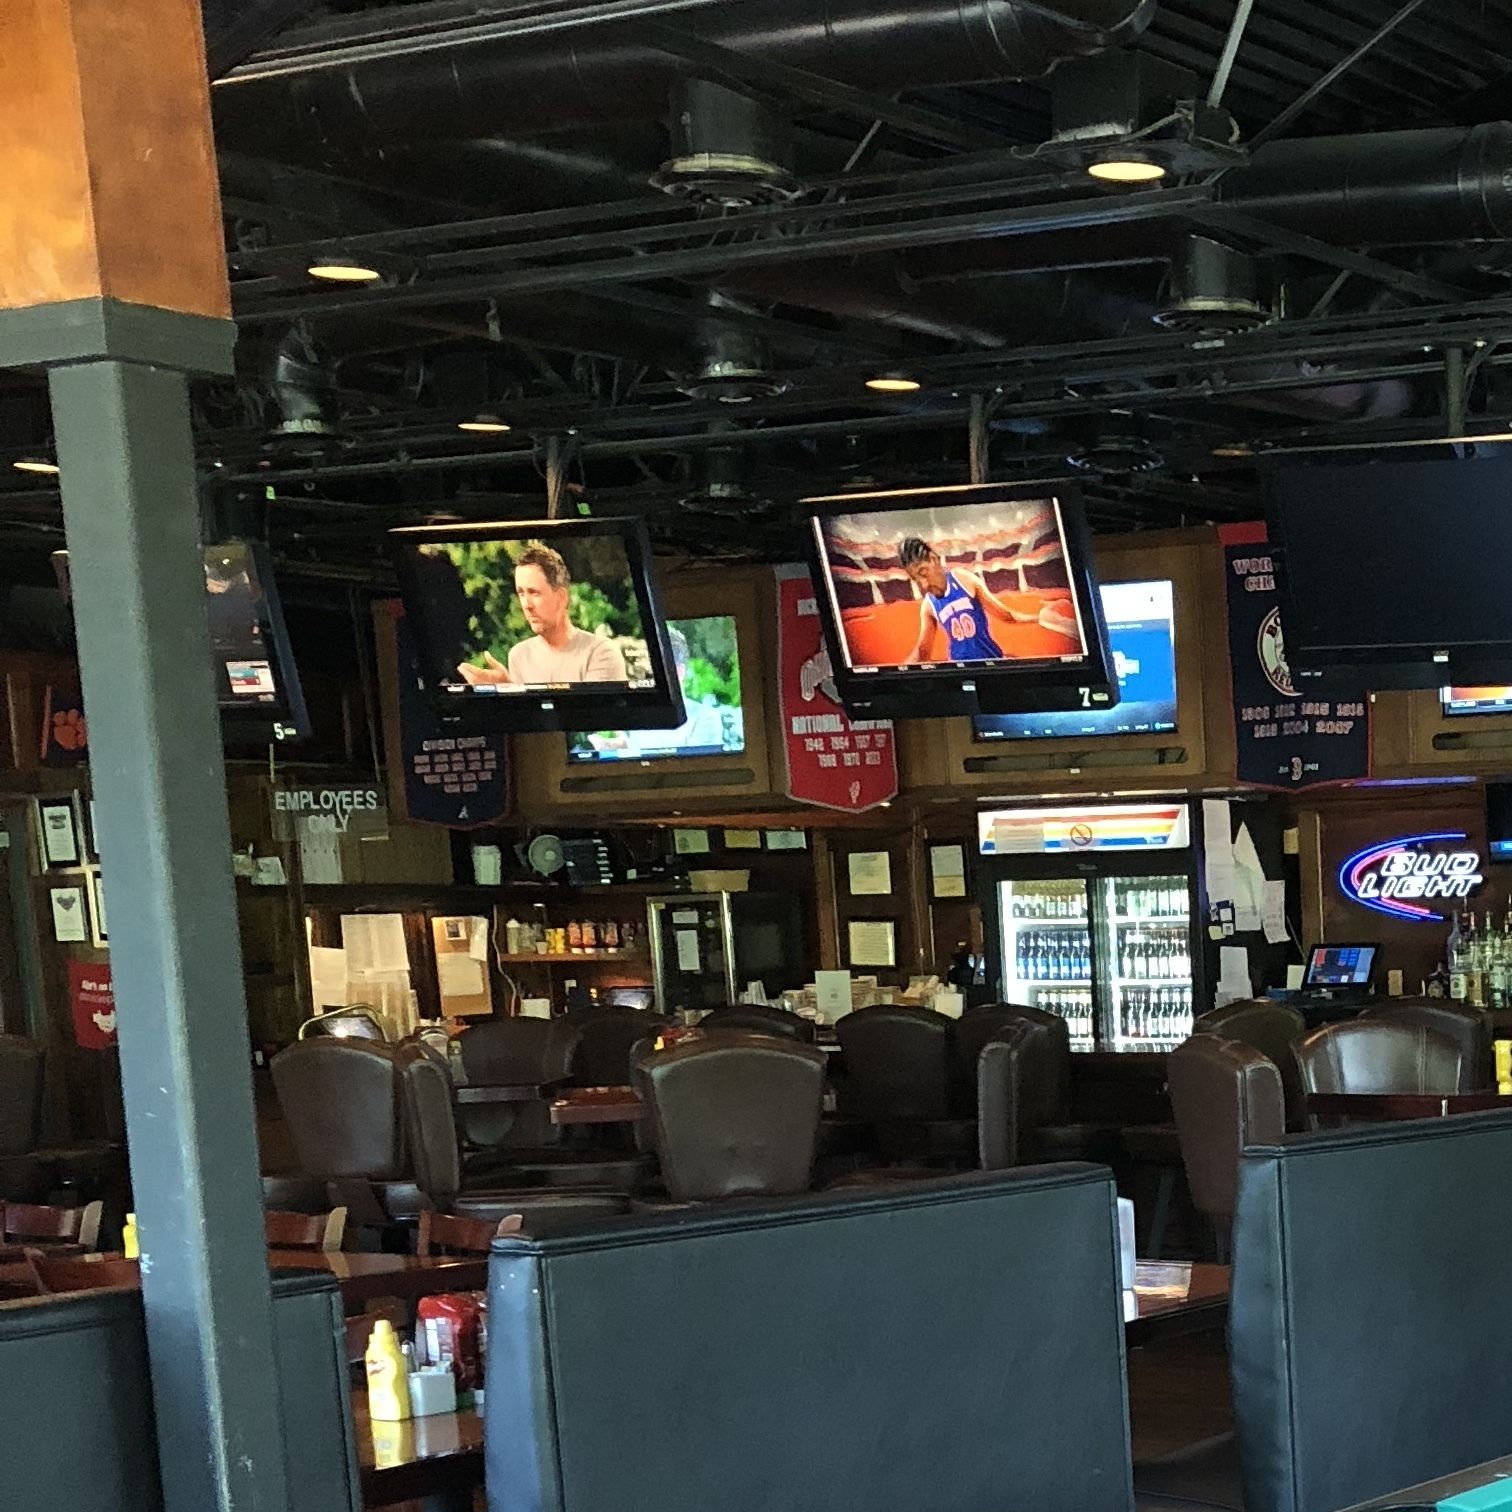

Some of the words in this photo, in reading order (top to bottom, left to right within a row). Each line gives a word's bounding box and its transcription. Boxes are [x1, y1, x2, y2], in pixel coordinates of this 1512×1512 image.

[1078, 687, 1090, 707] 7
[273, 722, 285, 740] 5
[792, 714, 844, 735] NATIONAL
[1315, 720, 1354, 734] 2007
[275, 790, 378, 811] EMPLOYEES
[308, 814, 349, 832] ONLY
[1380, 852, 1480, 876] BUD
[1357, 873, 1483, 898] LIGHT
